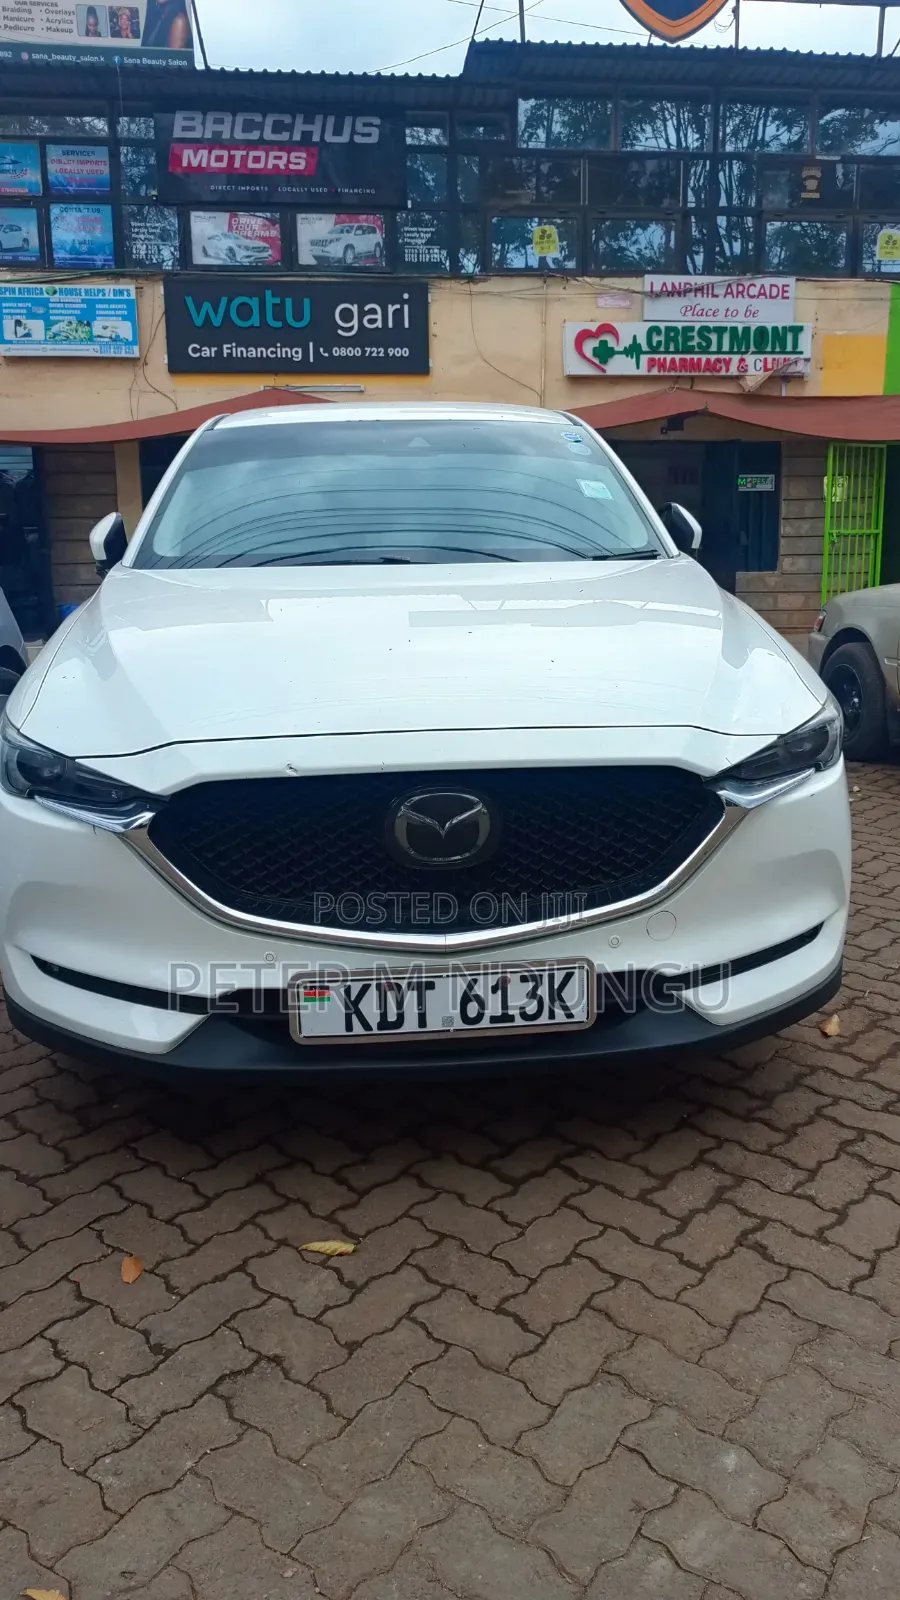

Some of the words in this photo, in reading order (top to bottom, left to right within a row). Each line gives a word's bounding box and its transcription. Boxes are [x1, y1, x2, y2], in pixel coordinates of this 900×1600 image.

[2, 6, 32, 14] Braiding
[44, 8, 76, 16] Overlays
[45, 17, 74, 25] Acrylics
[46, 26, 73, 34] Makeup
[142, 57, 167, 66] Beauty
[168, 58, 188, 66] Salon
[172, 110, 382, 143] BACCHUS
[61, 149, 96, 157] SERVICES
[181, 148, 308, 170] MOTORS
[238, 184, 269, 192] IMPORTS
[278, 185, 309, 193] LOCALLY
[337, 186, 376, 194] FINANCING
[231, 217, 263, 225] DRIVE
[0, 286, 17, 296] SPIN
[17, 287, 45, 296] AFRICA
[58, 287, 83, 297] HOUSE
[84, 288, 106, 297] HELPS
[649, 281, 720, 298] LANPHIL
[723, 282, 790, 300] ARCADE
[184, 289, 312, 329] watu
[334, 293, 410, 337] gari
[679, 304, 720, 318] Place
[724, 306, 739, 318] to
[744, 305, 760, 318] be
[646, 325, 804, 352] CRESTMONT
[187, 343, 218, 358] Car
[222, 343, 303, 362] Financing
[332, 347, 362, 357] 0800
[364, 347, 385, 358] 722
[387, 347, 410, 358] 900
[647, 357, 733, 373] PHARMACY
[737, 357, 749, 373] &
[344, 980, 436, 1033] KDT
[459, 971, 576, 1026] 613K
